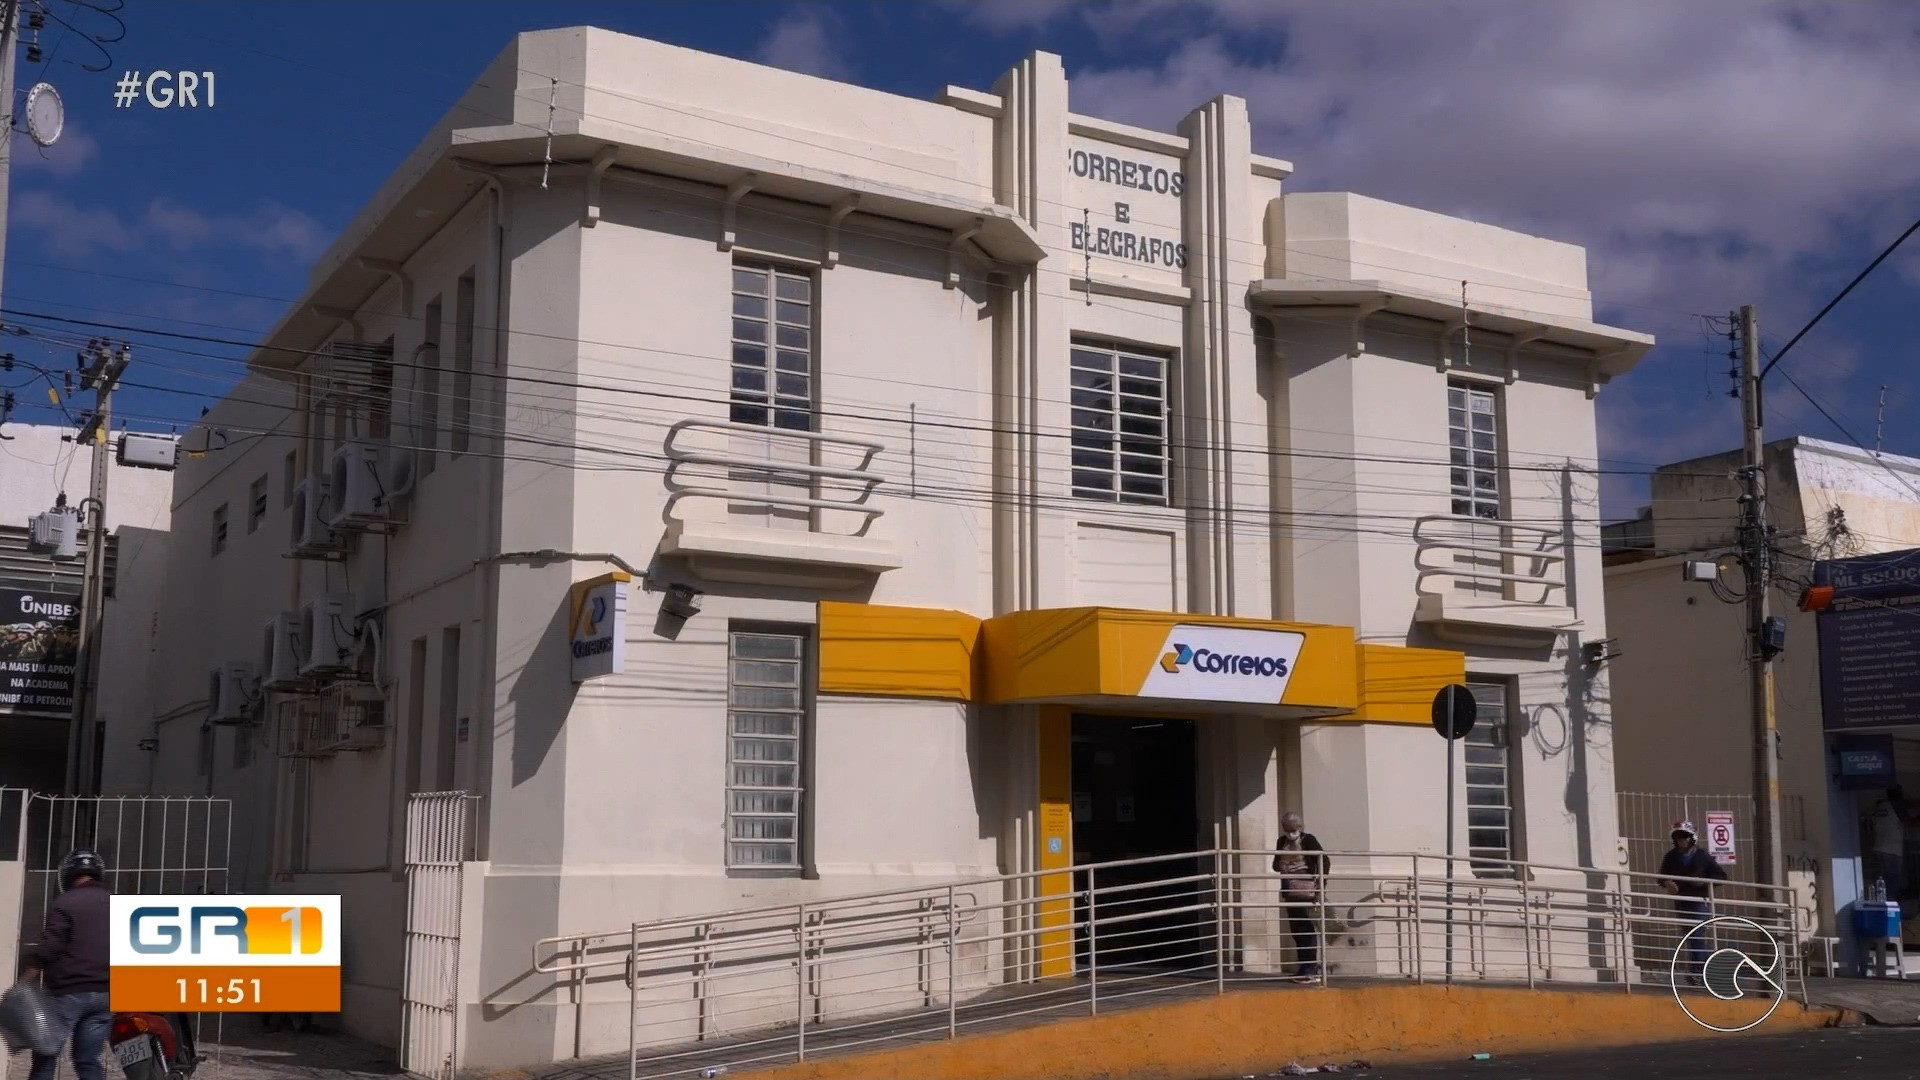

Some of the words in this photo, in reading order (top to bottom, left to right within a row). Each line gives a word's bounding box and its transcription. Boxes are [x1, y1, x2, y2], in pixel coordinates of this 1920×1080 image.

[1114, 202, 1130, 224] E
[1069, 221, 1188, 269] ELEGRAFOS
[1862, 567, 1920, 585] SOLUÇ
[9, 662, 30, 672] MAIS
[1193, 649, 1288, 677] Correios
[11, 678, 24, 688] NA
[26, 679, 68, 690] ACADEMIA
[23, 695, 35, 704] DE
